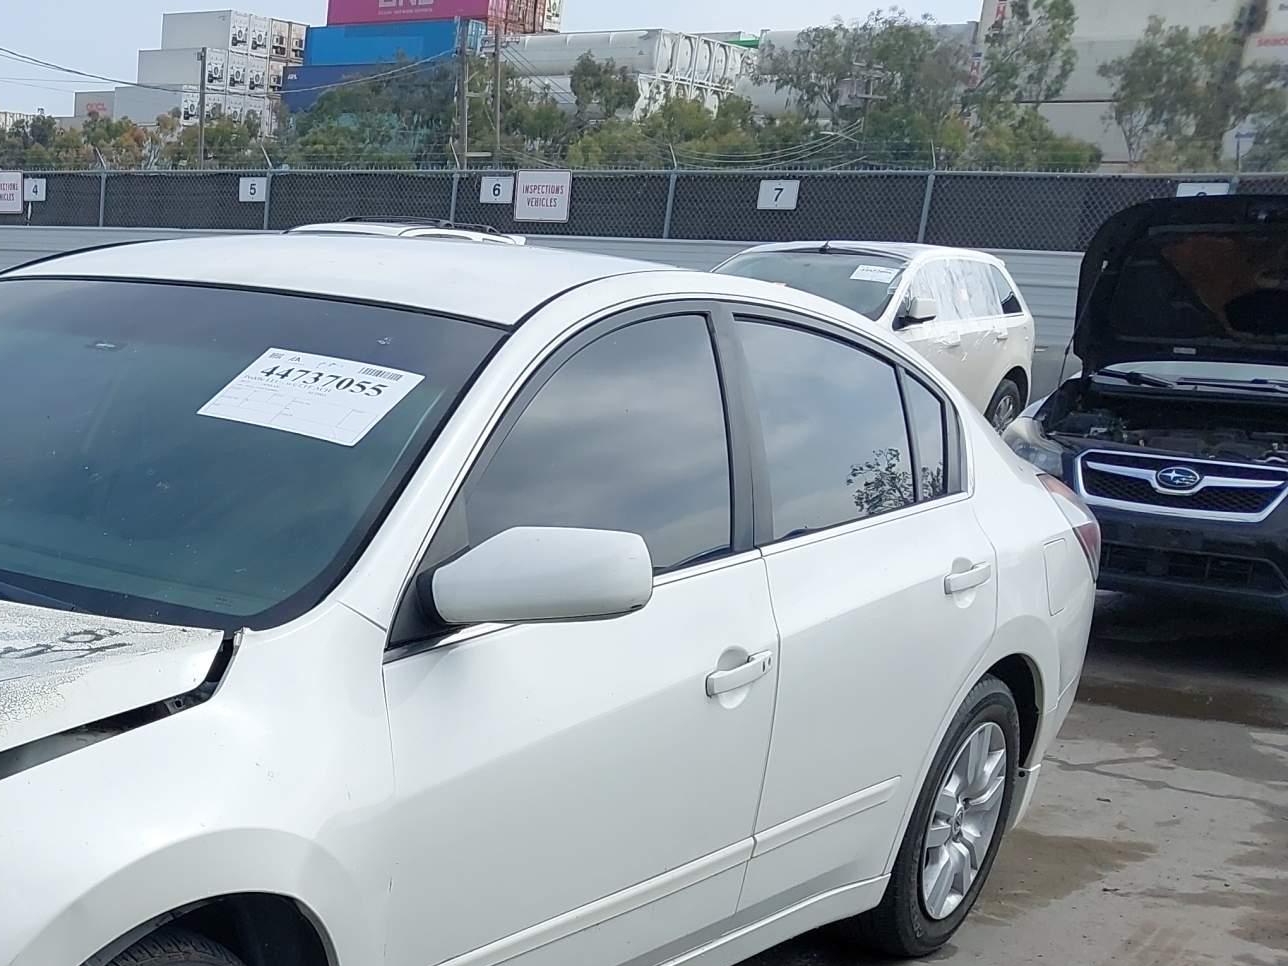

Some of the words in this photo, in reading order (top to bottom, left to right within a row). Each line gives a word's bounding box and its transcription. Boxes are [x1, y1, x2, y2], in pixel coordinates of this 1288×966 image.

[32, 185, 38, 195] 4
[249, 184, 257, 196] 5
[493, 184, 501, 196] 6
[523, 185, 564, 194] INSPECTIONS
[774, 188, 784, 201] 7
[527, 198, 557, 207] VEHICLES
[260, 365, 389, 396] 44737055
